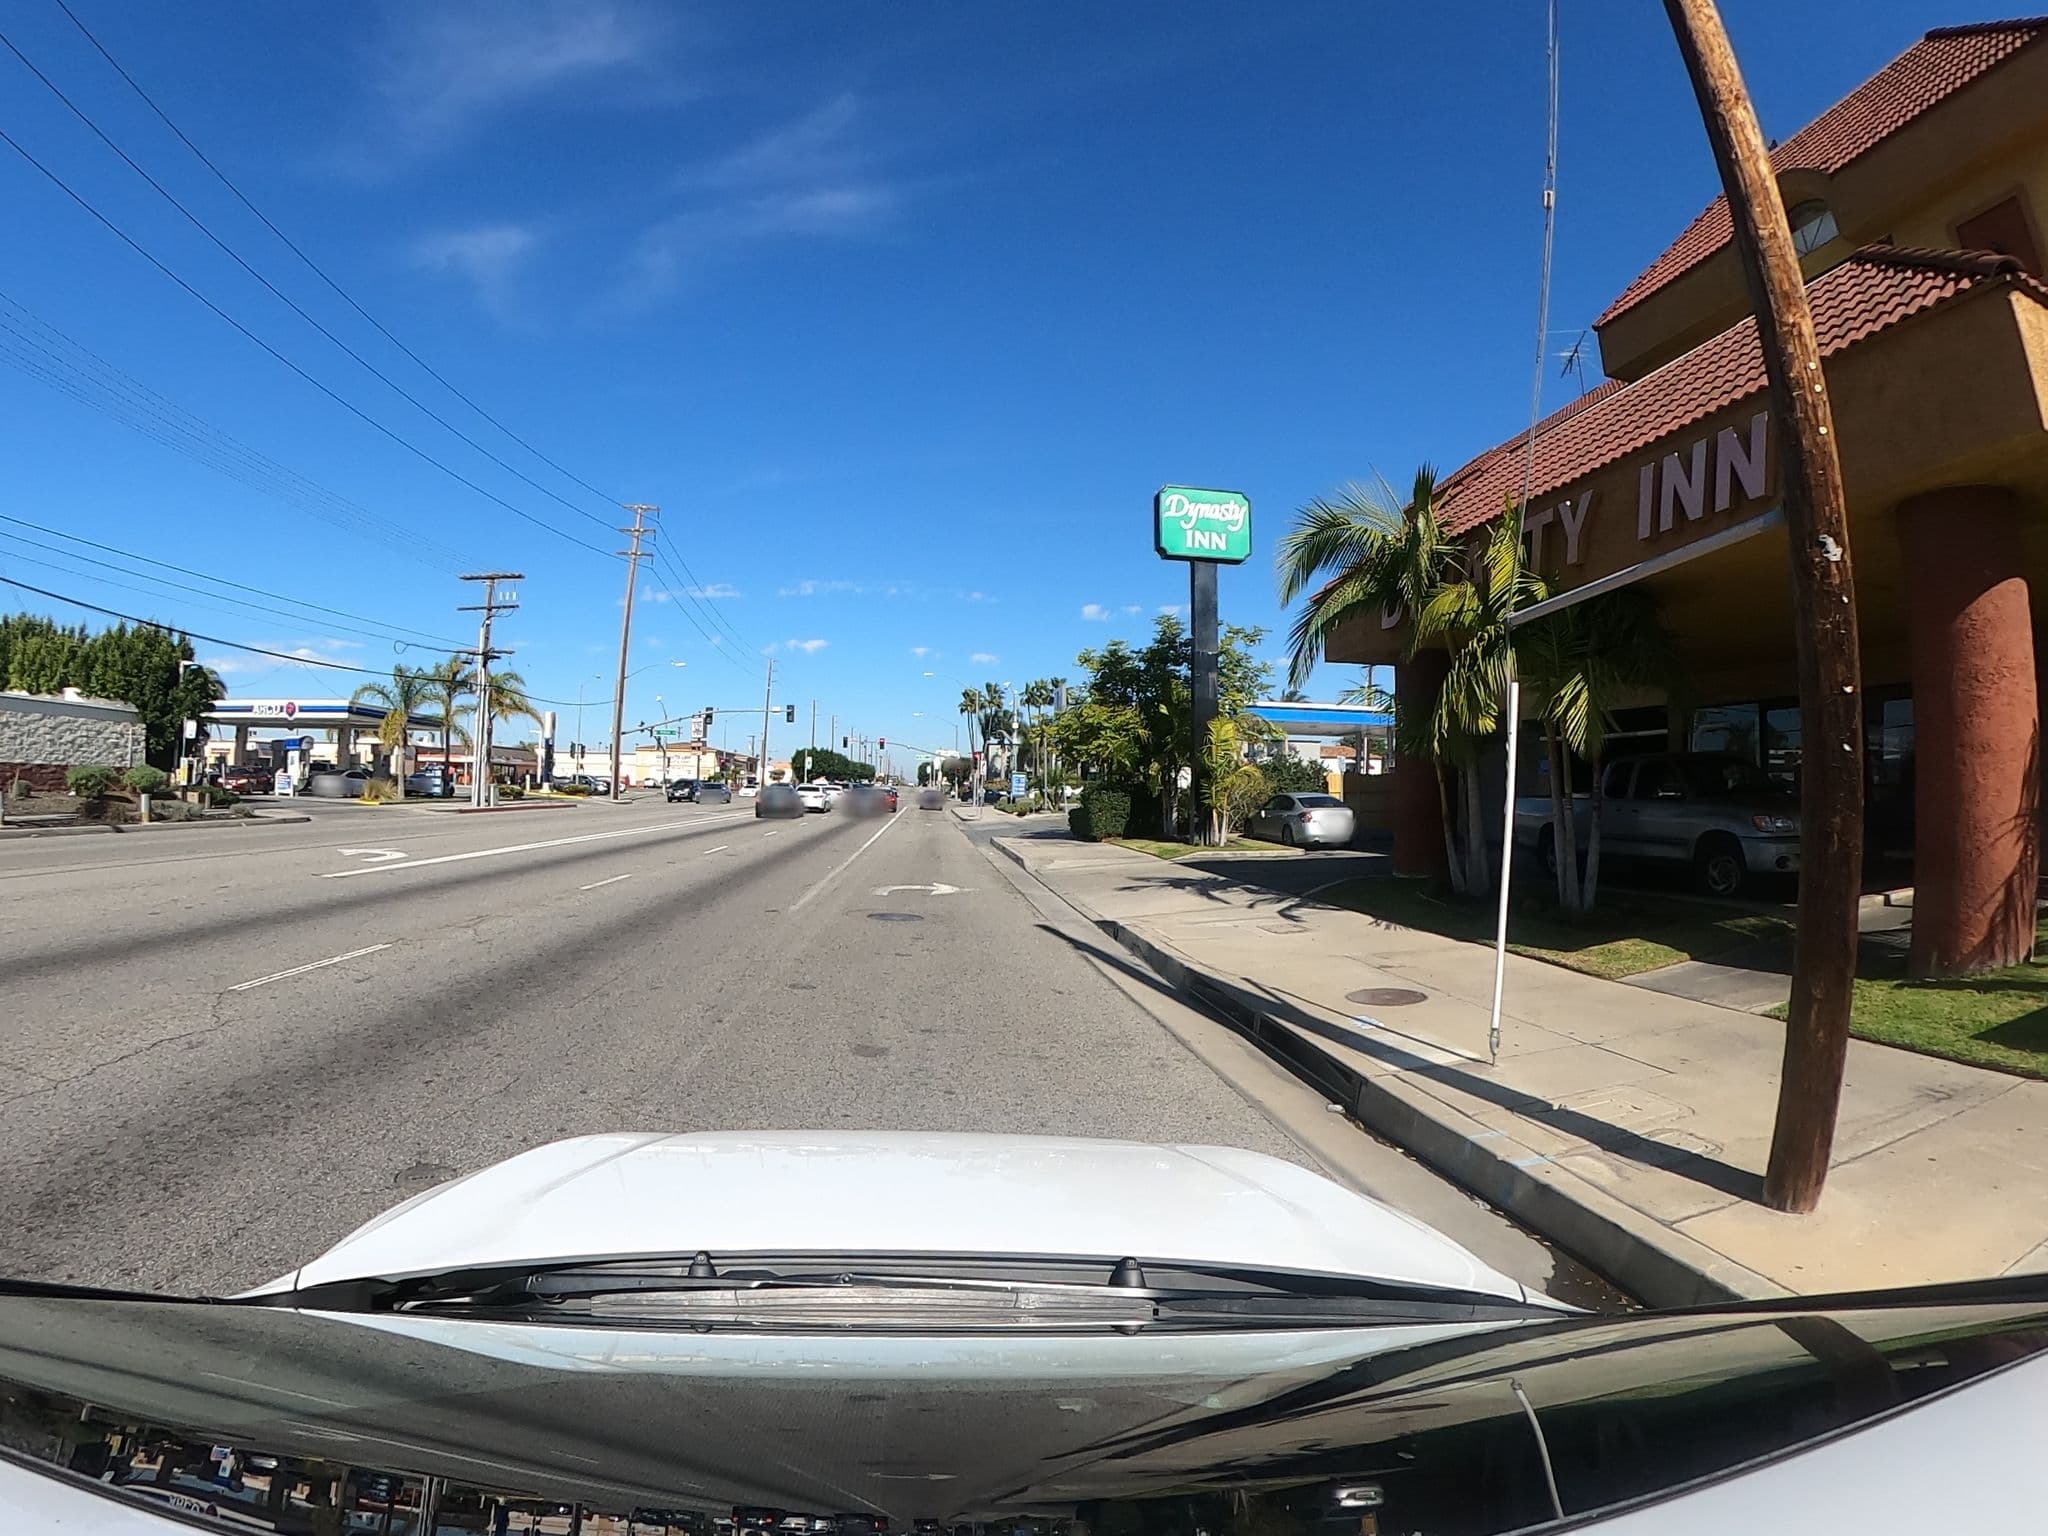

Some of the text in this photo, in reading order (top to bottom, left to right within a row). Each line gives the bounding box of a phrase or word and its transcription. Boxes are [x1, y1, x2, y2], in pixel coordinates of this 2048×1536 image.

[1637, 411, 1768, 541] INN
[1164, 493, 1247, 532] Dynasty
[1185, 529, 1227, 551] INN
